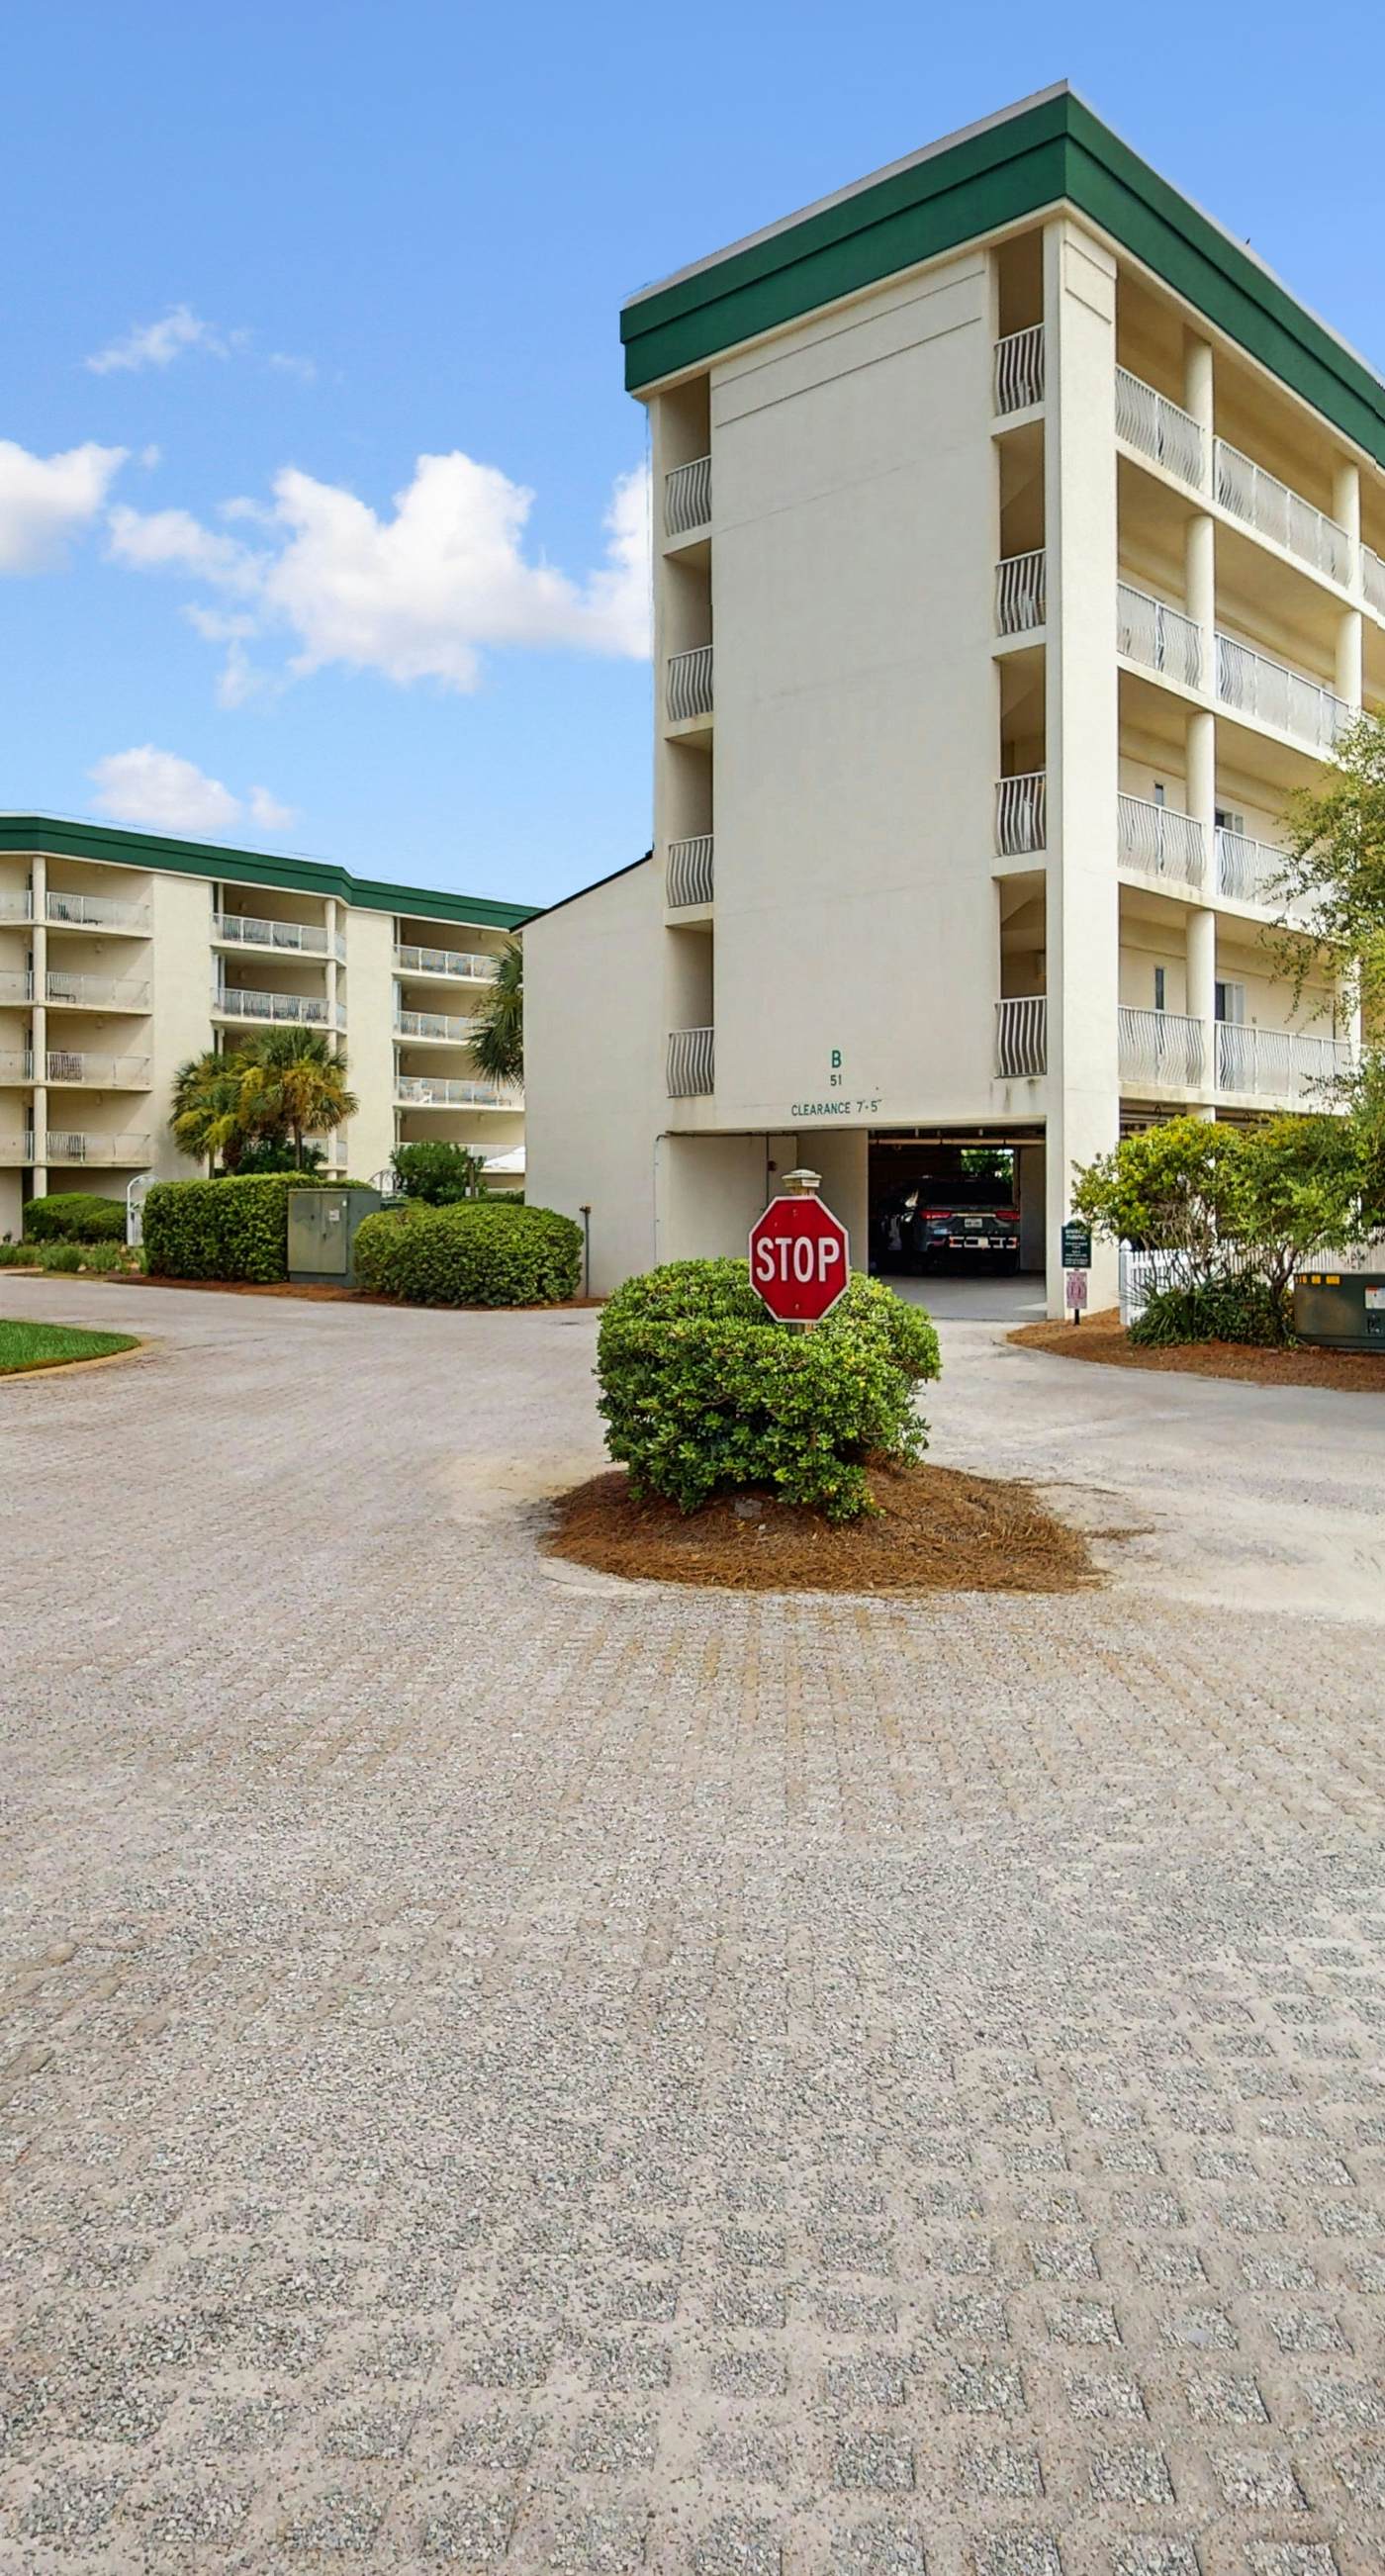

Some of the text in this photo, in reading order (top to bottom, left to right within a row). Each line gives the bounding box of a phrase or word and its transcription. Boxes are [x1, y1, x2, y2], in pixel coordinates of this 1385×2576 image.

[832, 1050, 842, 1068] B
[830, 1074, 842, 1086] 51
[791, 1101, 851, 1116] CLEARANCE
[756, 1236, 840, 1282] STOP
